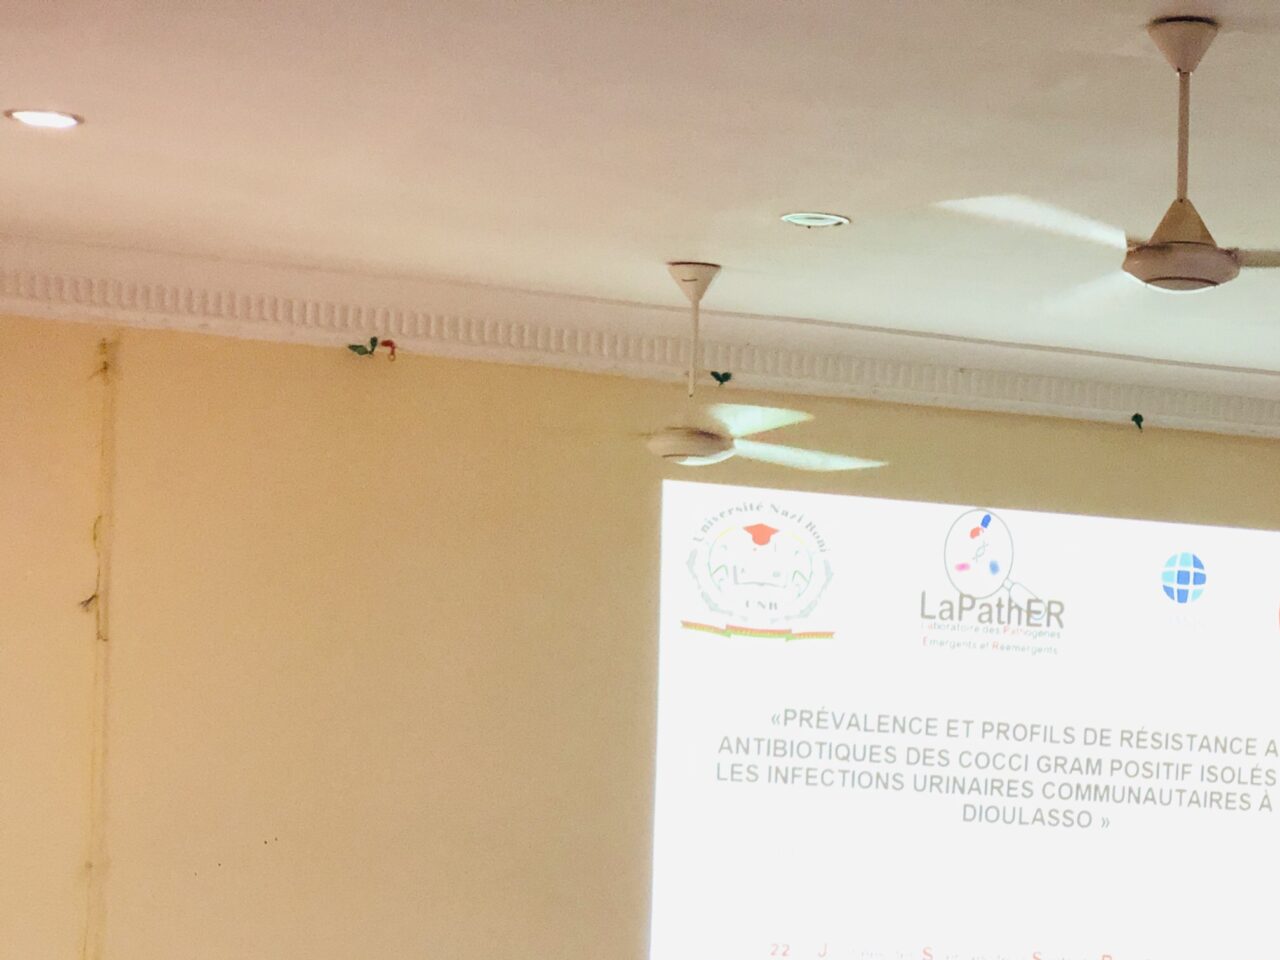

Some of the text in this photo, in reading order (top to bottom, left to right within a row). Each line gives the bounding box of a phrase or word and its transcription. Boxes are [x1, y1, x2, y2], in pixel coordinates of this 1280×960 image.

[920, 590, 1065, 629] LaPathER
[982, 625, 1000, 635] des
[946, 719, 975, 738] ET
[982, 721, 1076, 745] PROFILS
[1083, 727, 1113, 748] DE
[1119, 726, 1258, 756] RÉSISTANCE
[717, 736, 897, 765] ANTIBIOTIQUES
[905, 747, 951, 768] DES
[958, 750, 1029, 773] COCCI
[1036, 755, 1103, 776] GRAM
[1109, 758, 1193, 781] POSITIF
[1199, 763, 1277, 787] ISOLÉS
[716, 762, 760, 783] LES
[767, 764, 905, 791] INFECTIONS
[913, 773, 1035, 800] URINAIRES
[1041, 780, 1252, 811] COMMUNAUTAIRES
[1258, 789, 1273, 813] À
[962, 803, 1093, 829] DIOULASSO
